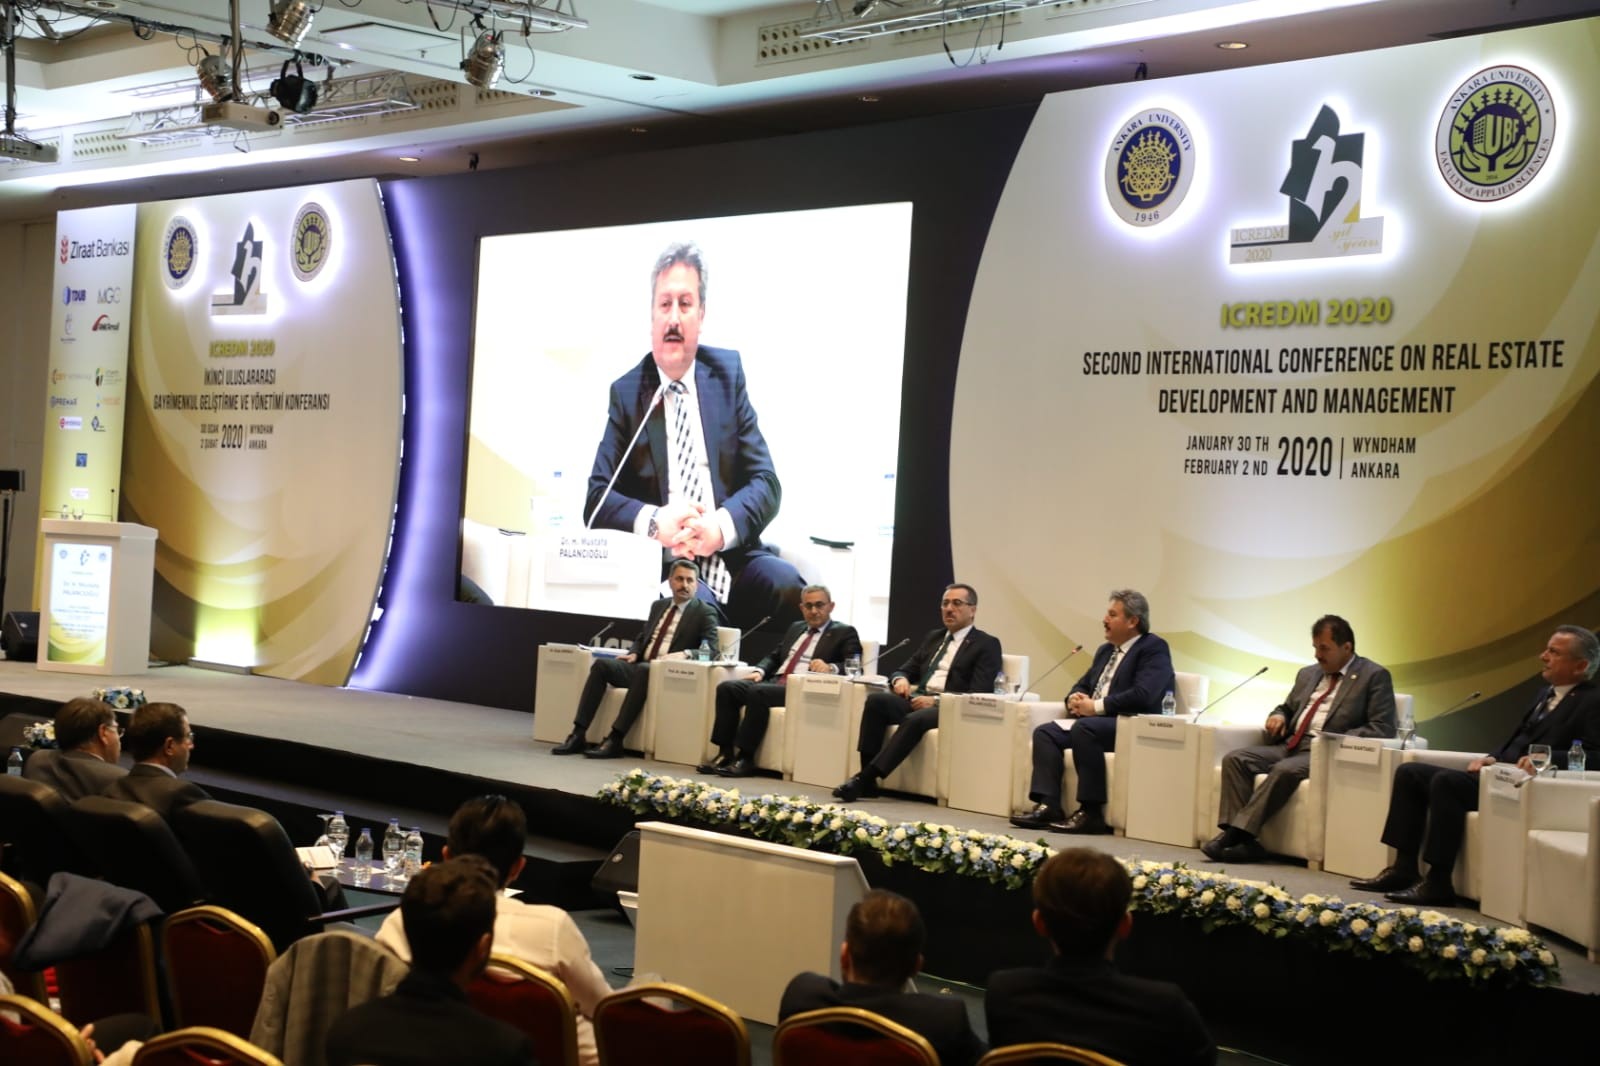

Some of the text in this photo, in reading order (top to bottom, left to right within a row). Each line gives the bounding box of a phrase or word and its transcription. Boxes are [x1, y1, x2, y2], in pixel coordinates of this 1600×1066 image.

[1491, 70, 1547, 103] UNIVERSITY
[1148, 113, 1193, 152] UNIVERSITY
[1474, 182, 1516, 198] APPLIED
[1515, 137, 1551, 185] SCIENCES
[1135, 210, 1160, 222] 1946
[1234, 226, 1285, 243] ICREDM
[71, 241, 96, 260] Ziraat
[1244, 248, 1273, 263] 2020
[1220, 297, 1394, 331] ICREDM 2020
[1083, 340, 1565, 375] SECOND INTERNATIONAL CONFERENCE ON REAL ESTATE
[226, 368, 276, 385] ULUSLARARASI
[285, 393, 331, 411] KONFERANSI
[1158, 386, 1456, 414] DEVELOPMENT AND MANAGEMENT
[221, 424, 244, 449] 2020
[1186, 435, 1269, 452] JANUARY 30 TH
[1352, 437, 1416, 454] WYNDHAM
[1277, 436, 1332, 477] 2020
[1184, 459, 1268, 477] FEBRUARY 2 ND
[1351, 462, 1400, 479] ANKARA
